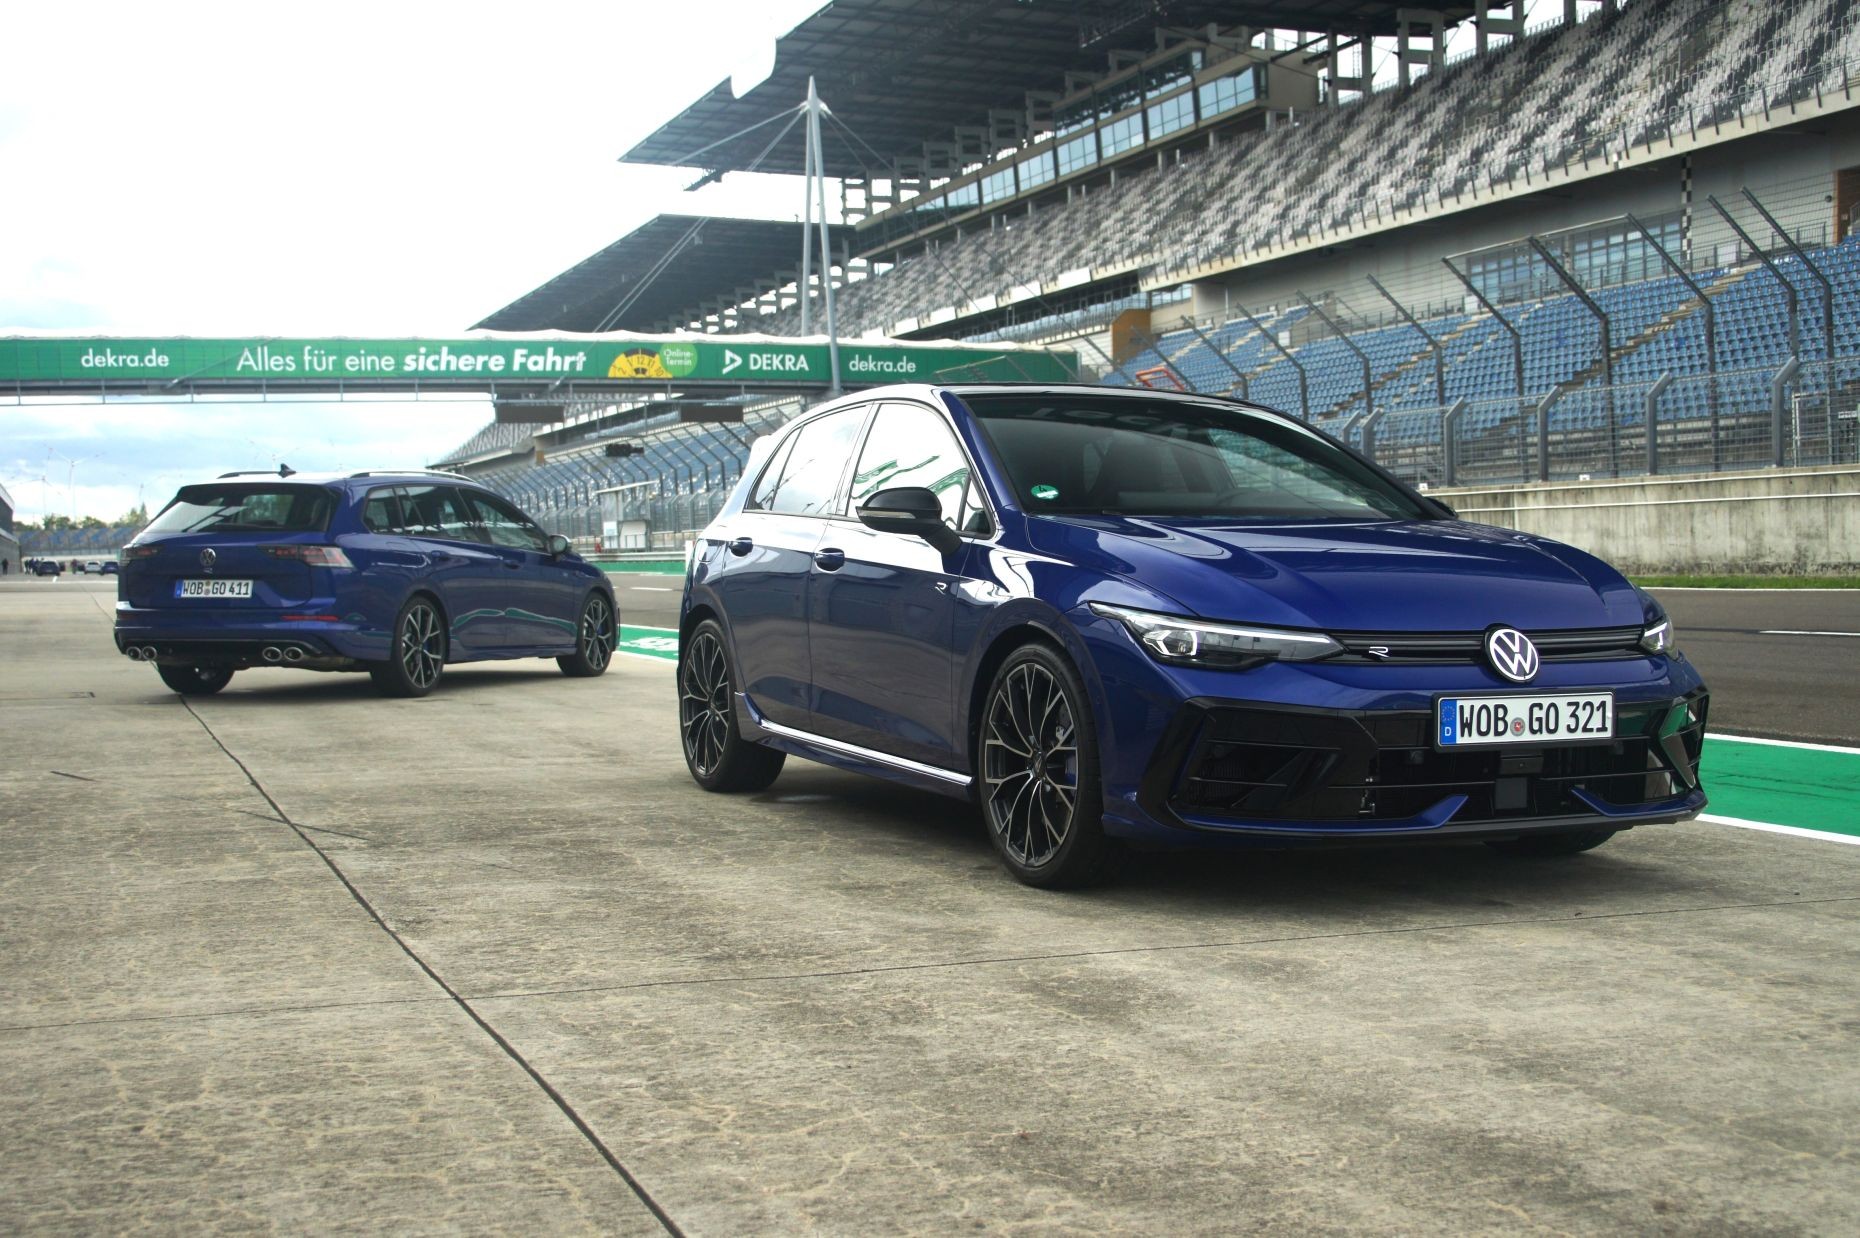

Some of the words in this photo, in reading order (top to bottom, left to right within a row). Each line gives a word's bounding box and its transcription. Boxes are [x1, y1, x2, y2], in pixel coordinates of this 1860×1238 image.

[80, 348, 170, 368] dekra.de
[236, 346, 297, 372] Alles
[302, 345, 338, 371] für
[344, 349, 396, 371] eine
[403, 347, 506, 372] sichere
[512, 347, 587, 372] Fahrt
[636, 356, 646, 366] 12
[663, 349, 694, 358] Online-
[665, 357, 693, 367] Termin
[749, 354, 809, 372] DEKRA
[849, 355, 917, 374] dekra.de
[183, 582, 204, 595] WOB
[211, 582, 227, 595] GO
[228, 582, 249, 596] 411
[1458, 703, 1509, 738] WOB
[1528, 702, 1560, 735] GO
[1566, 700, 1608, 734] 321
[1444, 726, 1452, 737] D
